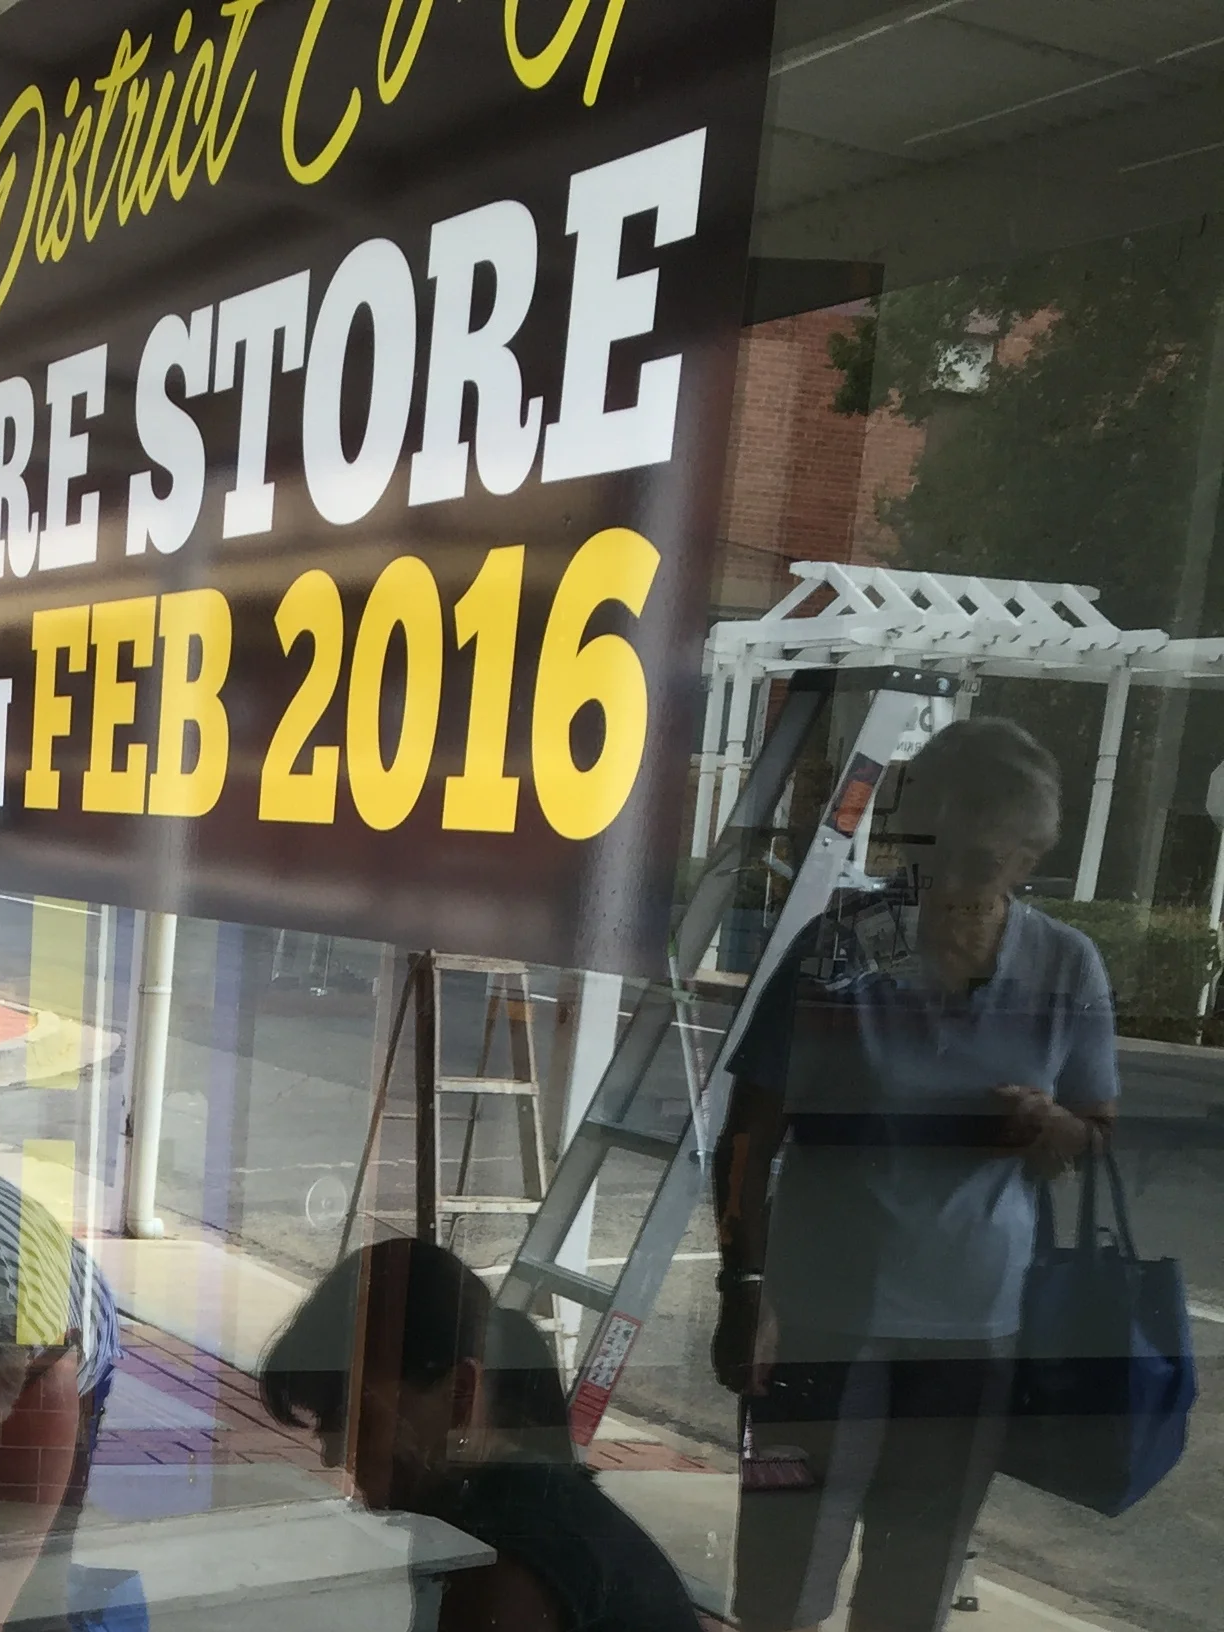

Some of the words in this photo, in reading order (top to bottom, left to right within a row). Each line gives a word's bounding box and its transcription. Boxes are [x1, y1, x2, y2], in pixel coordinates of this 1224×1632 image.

[126, 126, 707, 557] STORE
[24, 588, 233, 818] FEB
[258, 527, 661, 840] 2016
